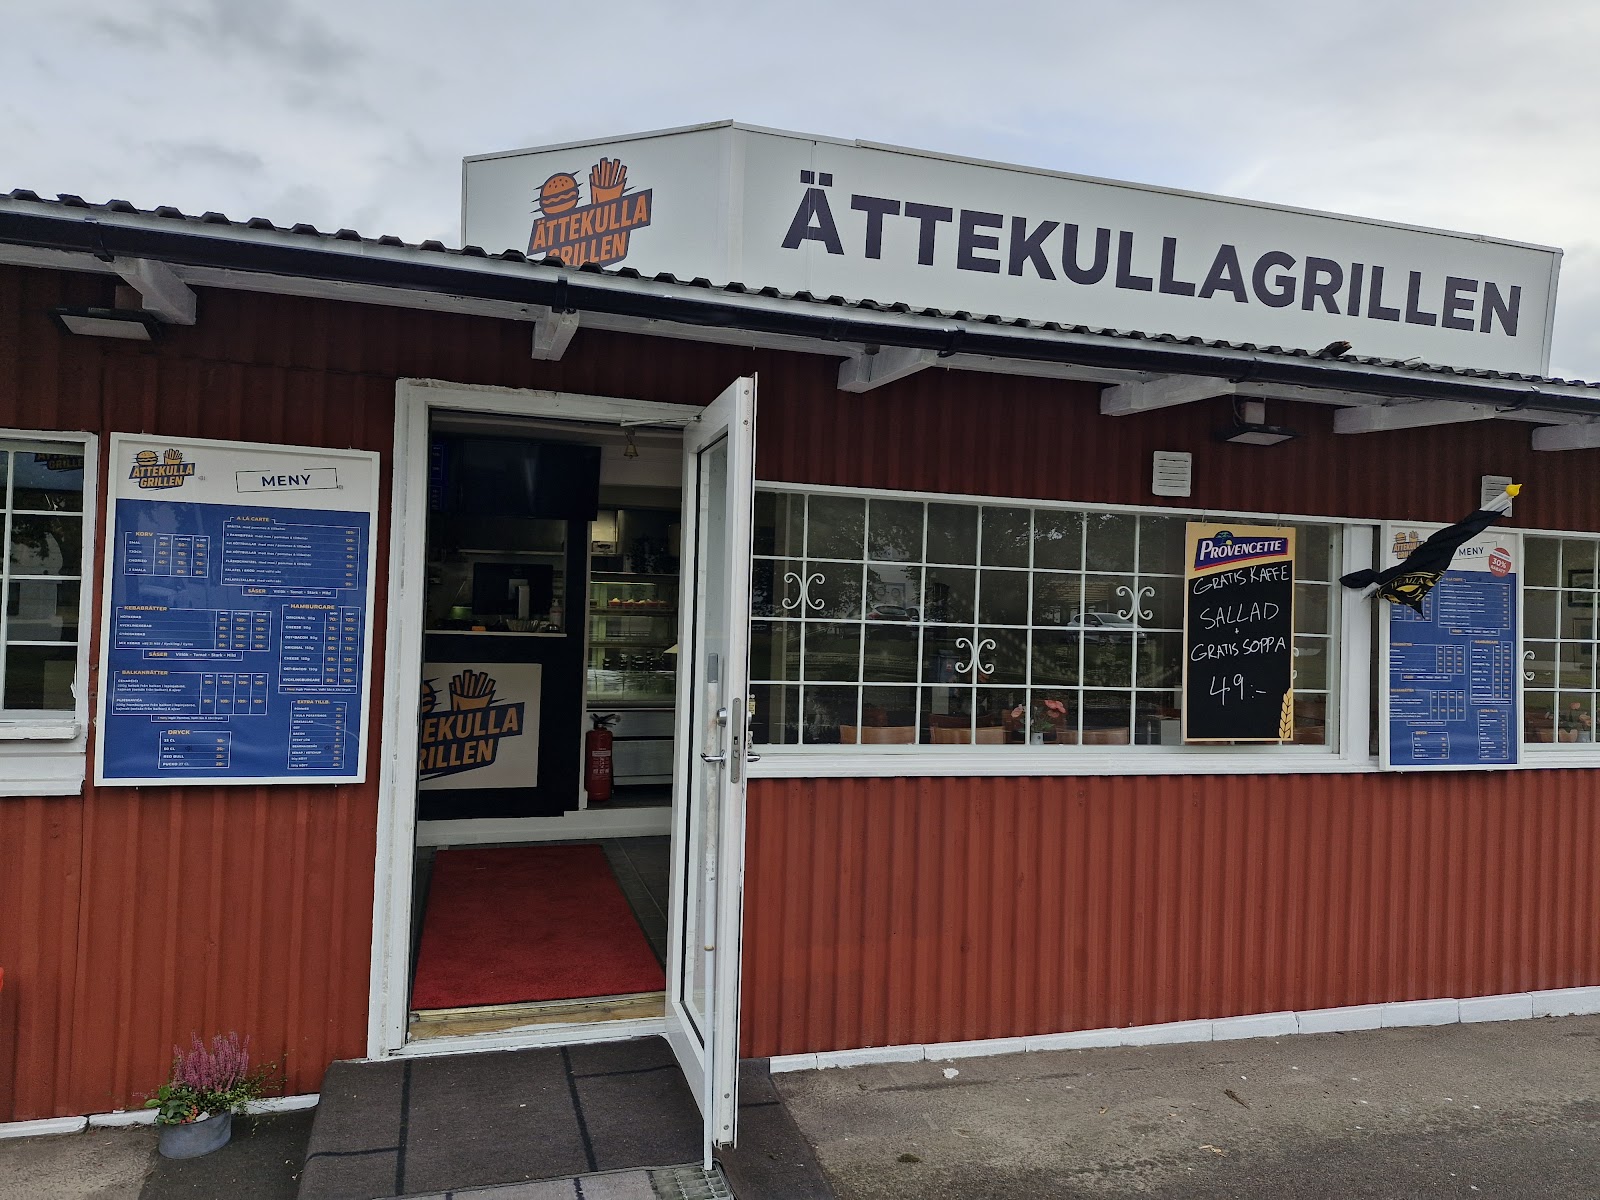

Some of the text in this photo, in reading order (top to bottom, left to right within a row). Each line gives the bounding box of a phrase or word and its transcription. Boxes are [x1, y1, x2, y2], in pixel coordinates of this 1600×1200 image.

[532, 194, 648, 250] ÄTTEKULLA
[781, 170, 1521, 337] ÄTTEKULLAGRILLEN
[140, 475, 183, 489] GRILLEN
[261, 475, 311, 487] MENY
[1199, 540, 1282, 560] PROVENCETTE
[1459, 547, 1484, 557] MENY
[1492, 557, 1507, 569] 30%
[1193, 565, 1290, 595] GRATIS KAFFE
[1199, 602, 1279, 630] SALLAD
[1190, 636, 1286, 662] GRATIS SOPPA
